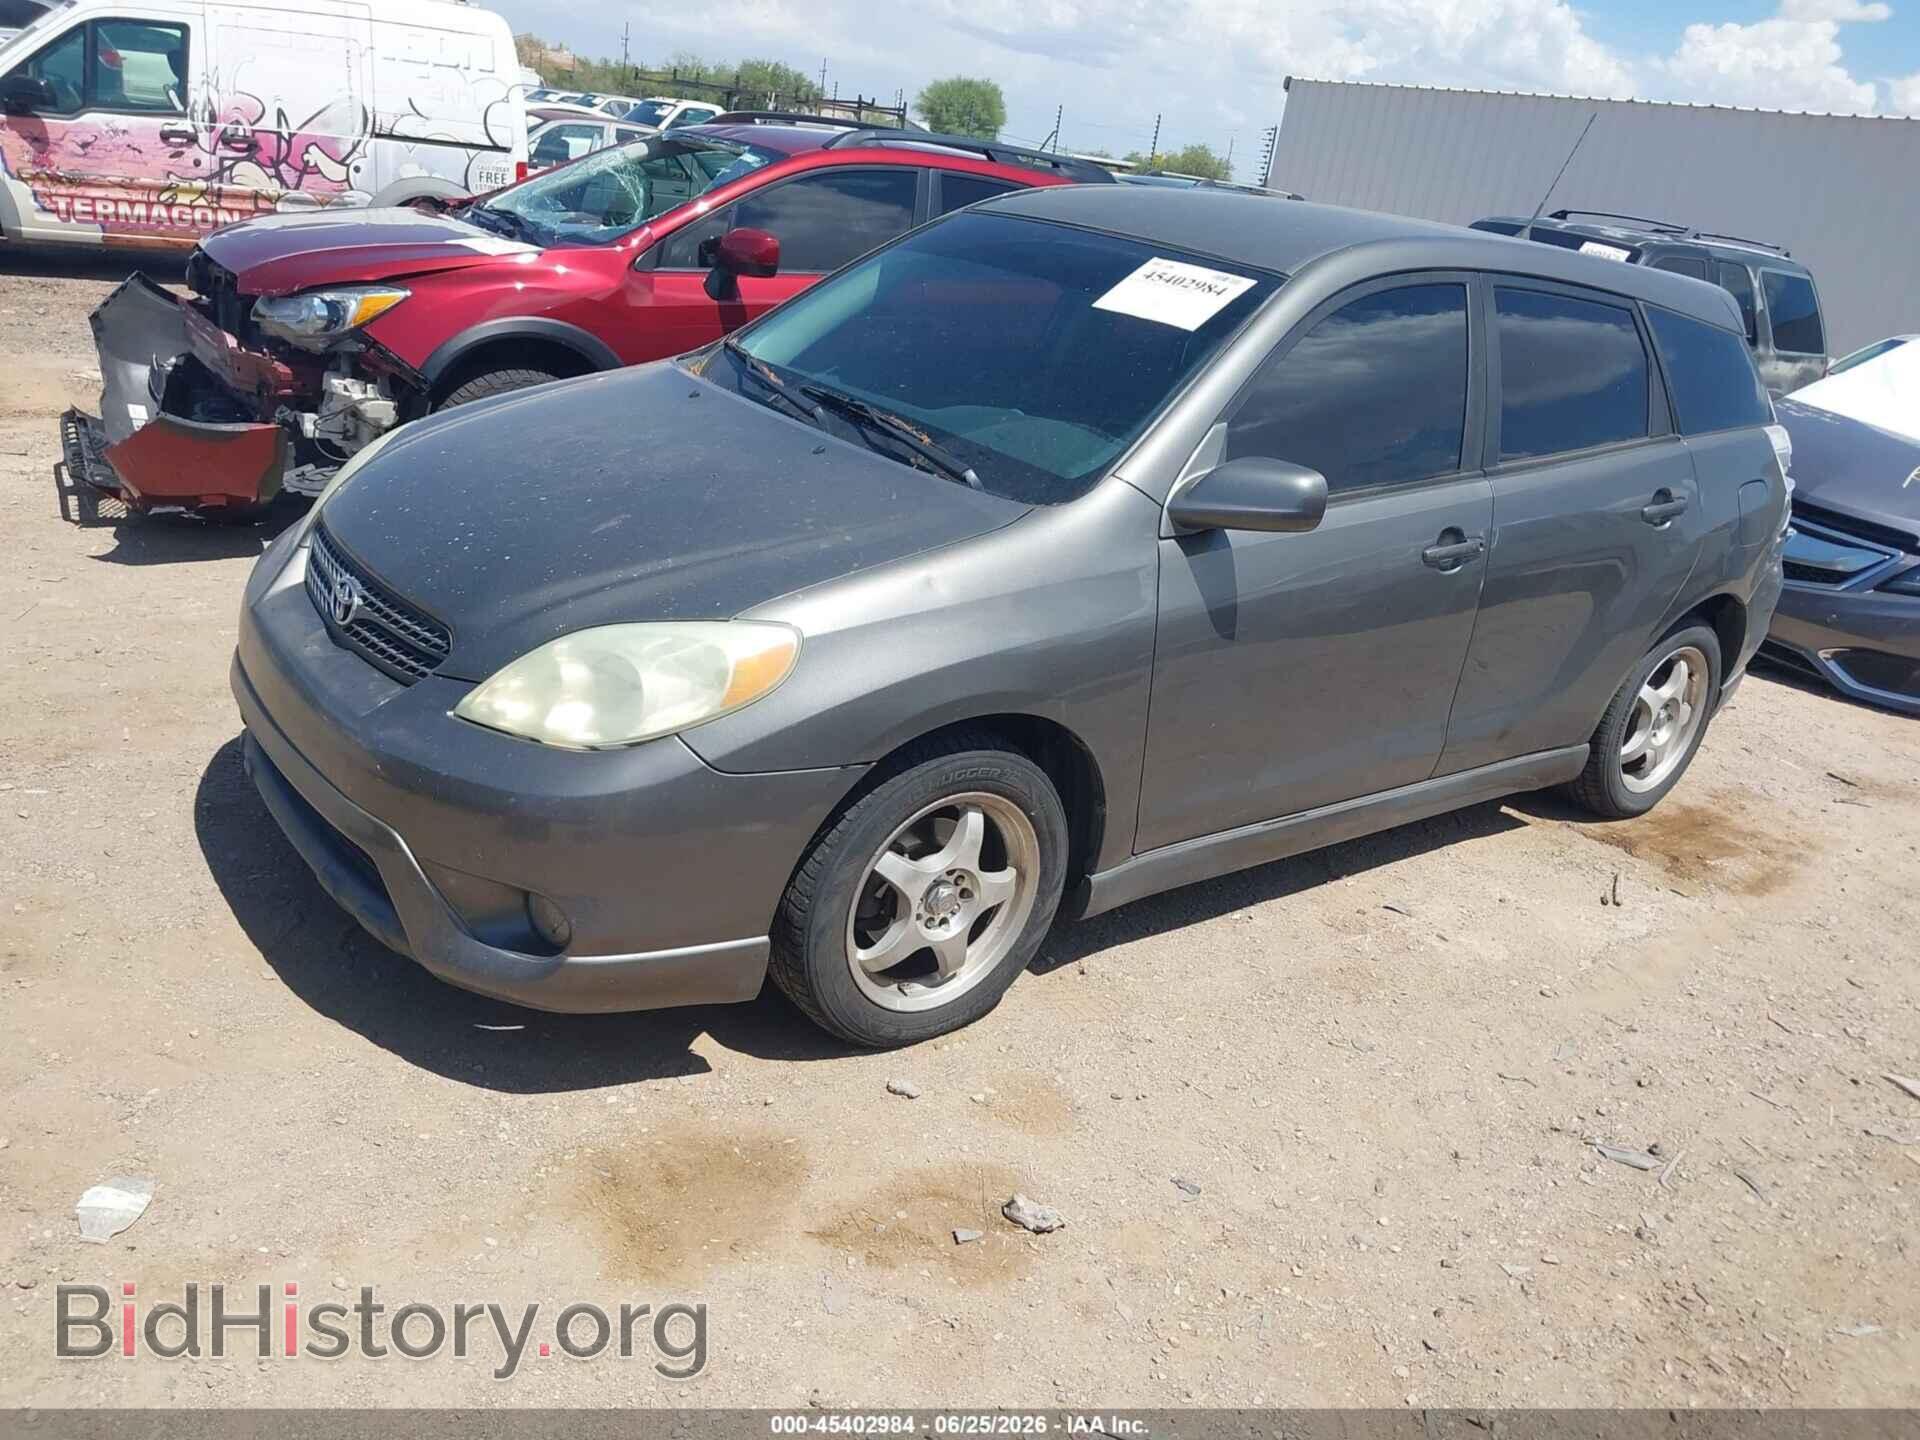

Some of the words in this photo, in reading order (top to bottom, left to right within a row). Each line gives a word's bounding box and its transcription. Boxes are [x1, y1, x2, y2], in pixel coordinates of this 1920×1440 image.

[479, 171, 506, 185] FREE
[51, 196, 240, 229] TERMAGON
[1143, 270, 1229, 297] 45402984
